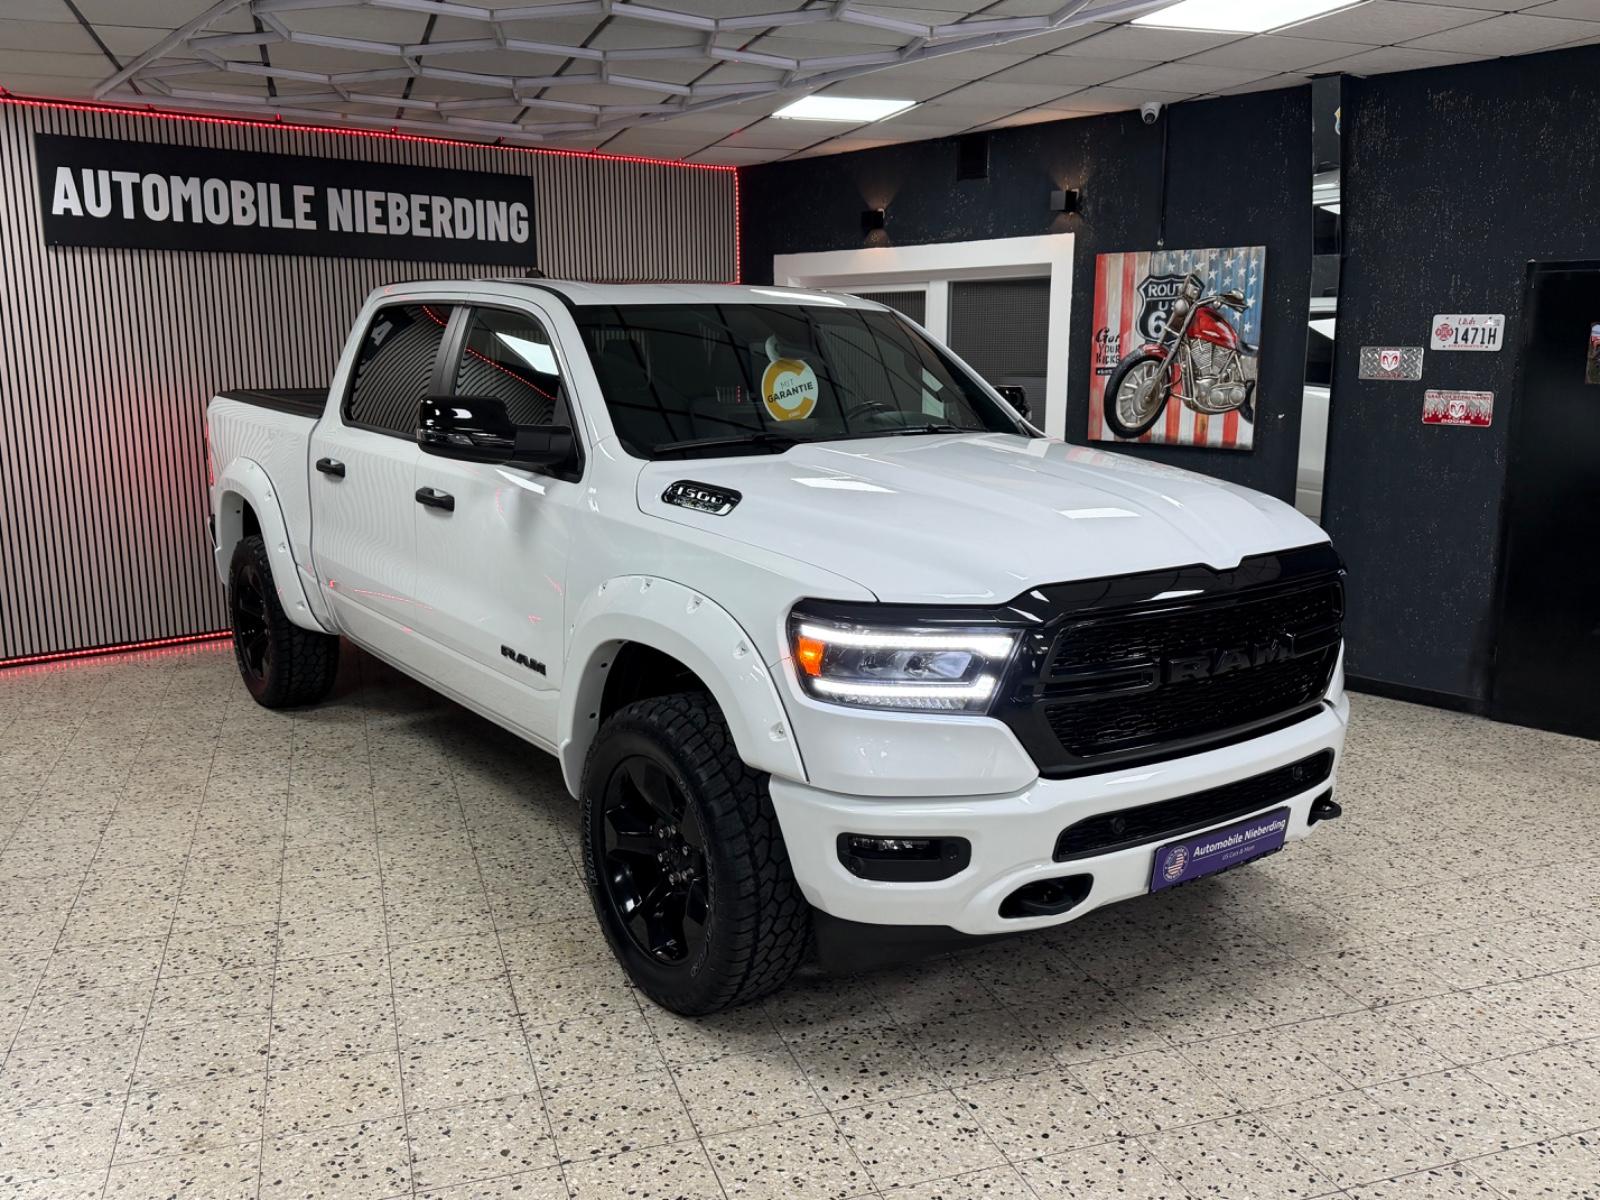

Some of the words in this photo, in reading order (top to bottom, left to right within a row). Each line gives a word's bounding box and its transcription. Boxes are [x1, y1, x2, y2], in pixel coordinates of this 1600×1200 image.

[51, 166, 317, 230] AUTOMOBILE
[327, 187, 530, 244] NIEBERDING
[1148, 284, 1184, 297] ROUT
[1453, 327, 1497, 345] 1471H
[767, 381, 814, 403] GARANTIE
[500, 644, 547, 677] RAM
[1168, 632, 1295, 684] RAM
[1193, 833, 1244, 858] Automobile
[1244, 819, 1286, 841] Nieberding
